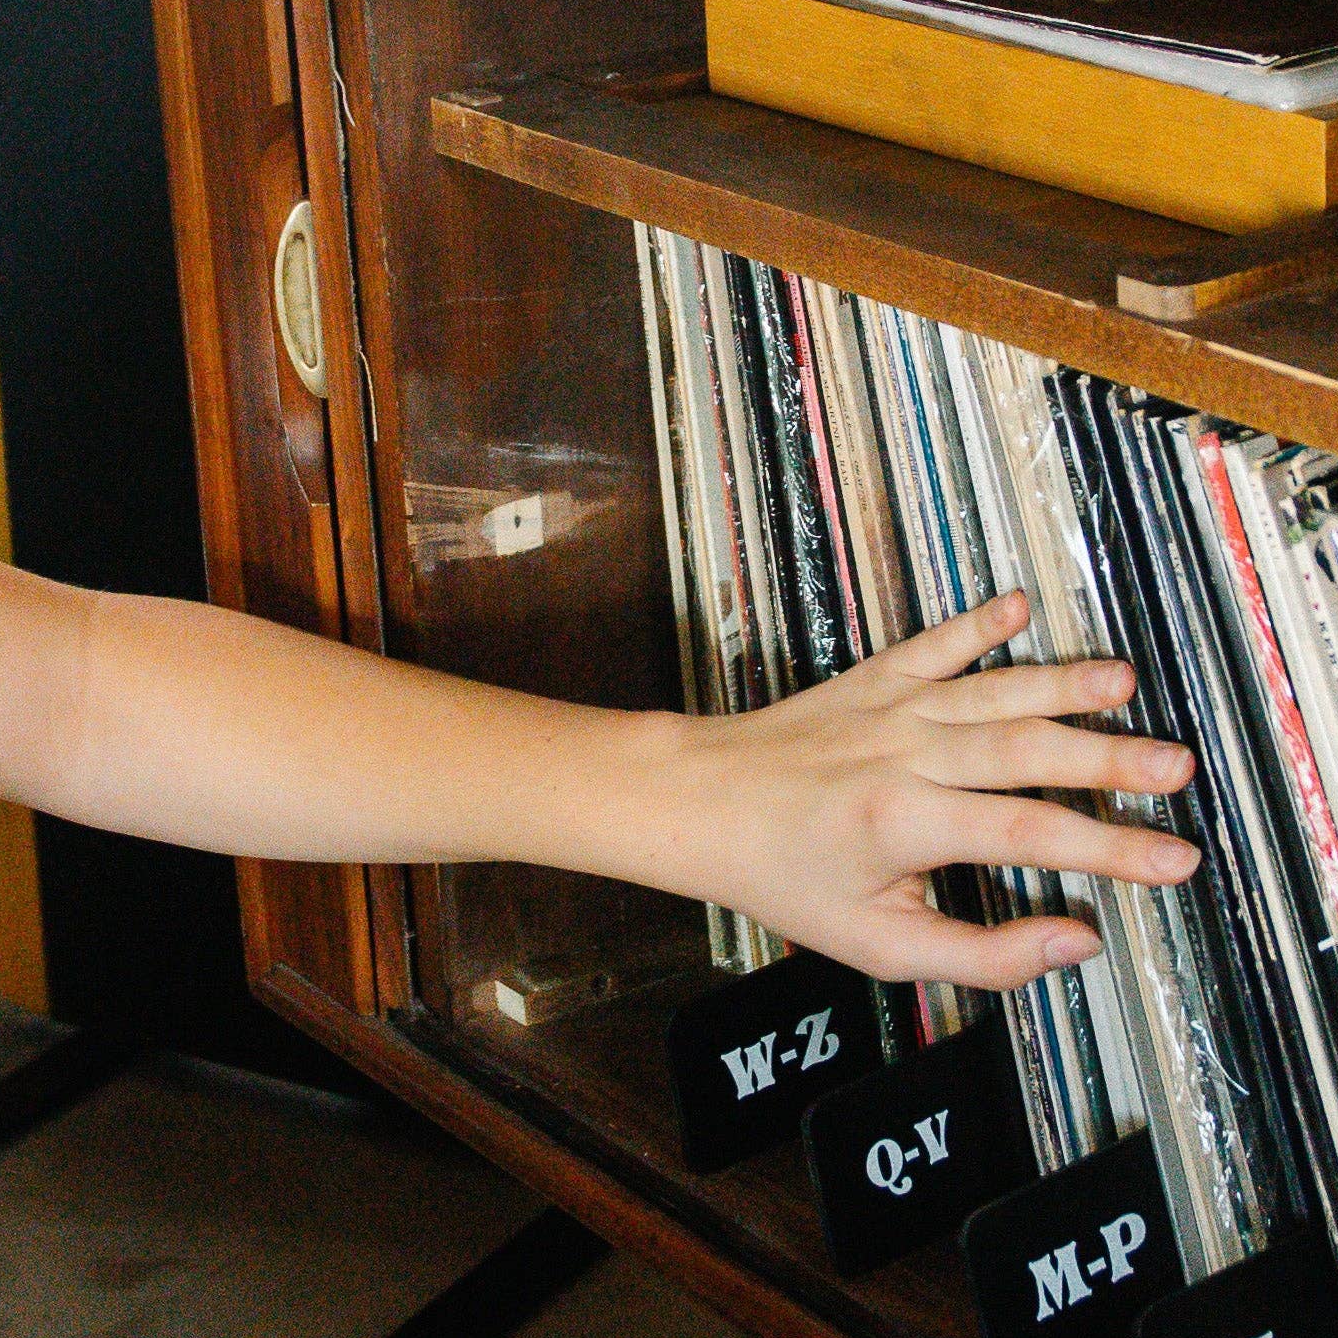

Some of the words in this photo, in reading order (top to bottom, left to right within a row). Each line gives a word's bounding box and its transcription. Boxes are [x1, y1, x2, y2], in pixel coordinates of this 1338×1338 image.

[813, 337, 826, 375] LINDA
[821, 378, 842, 451] McCARTNEY
[838, 458, 850, 487] RAM
[720, 1007, 841, 1101] W-Z
[866, 1110, 948, 1195] Q-V
[1029, 1213, 1146, 1321] M-P
